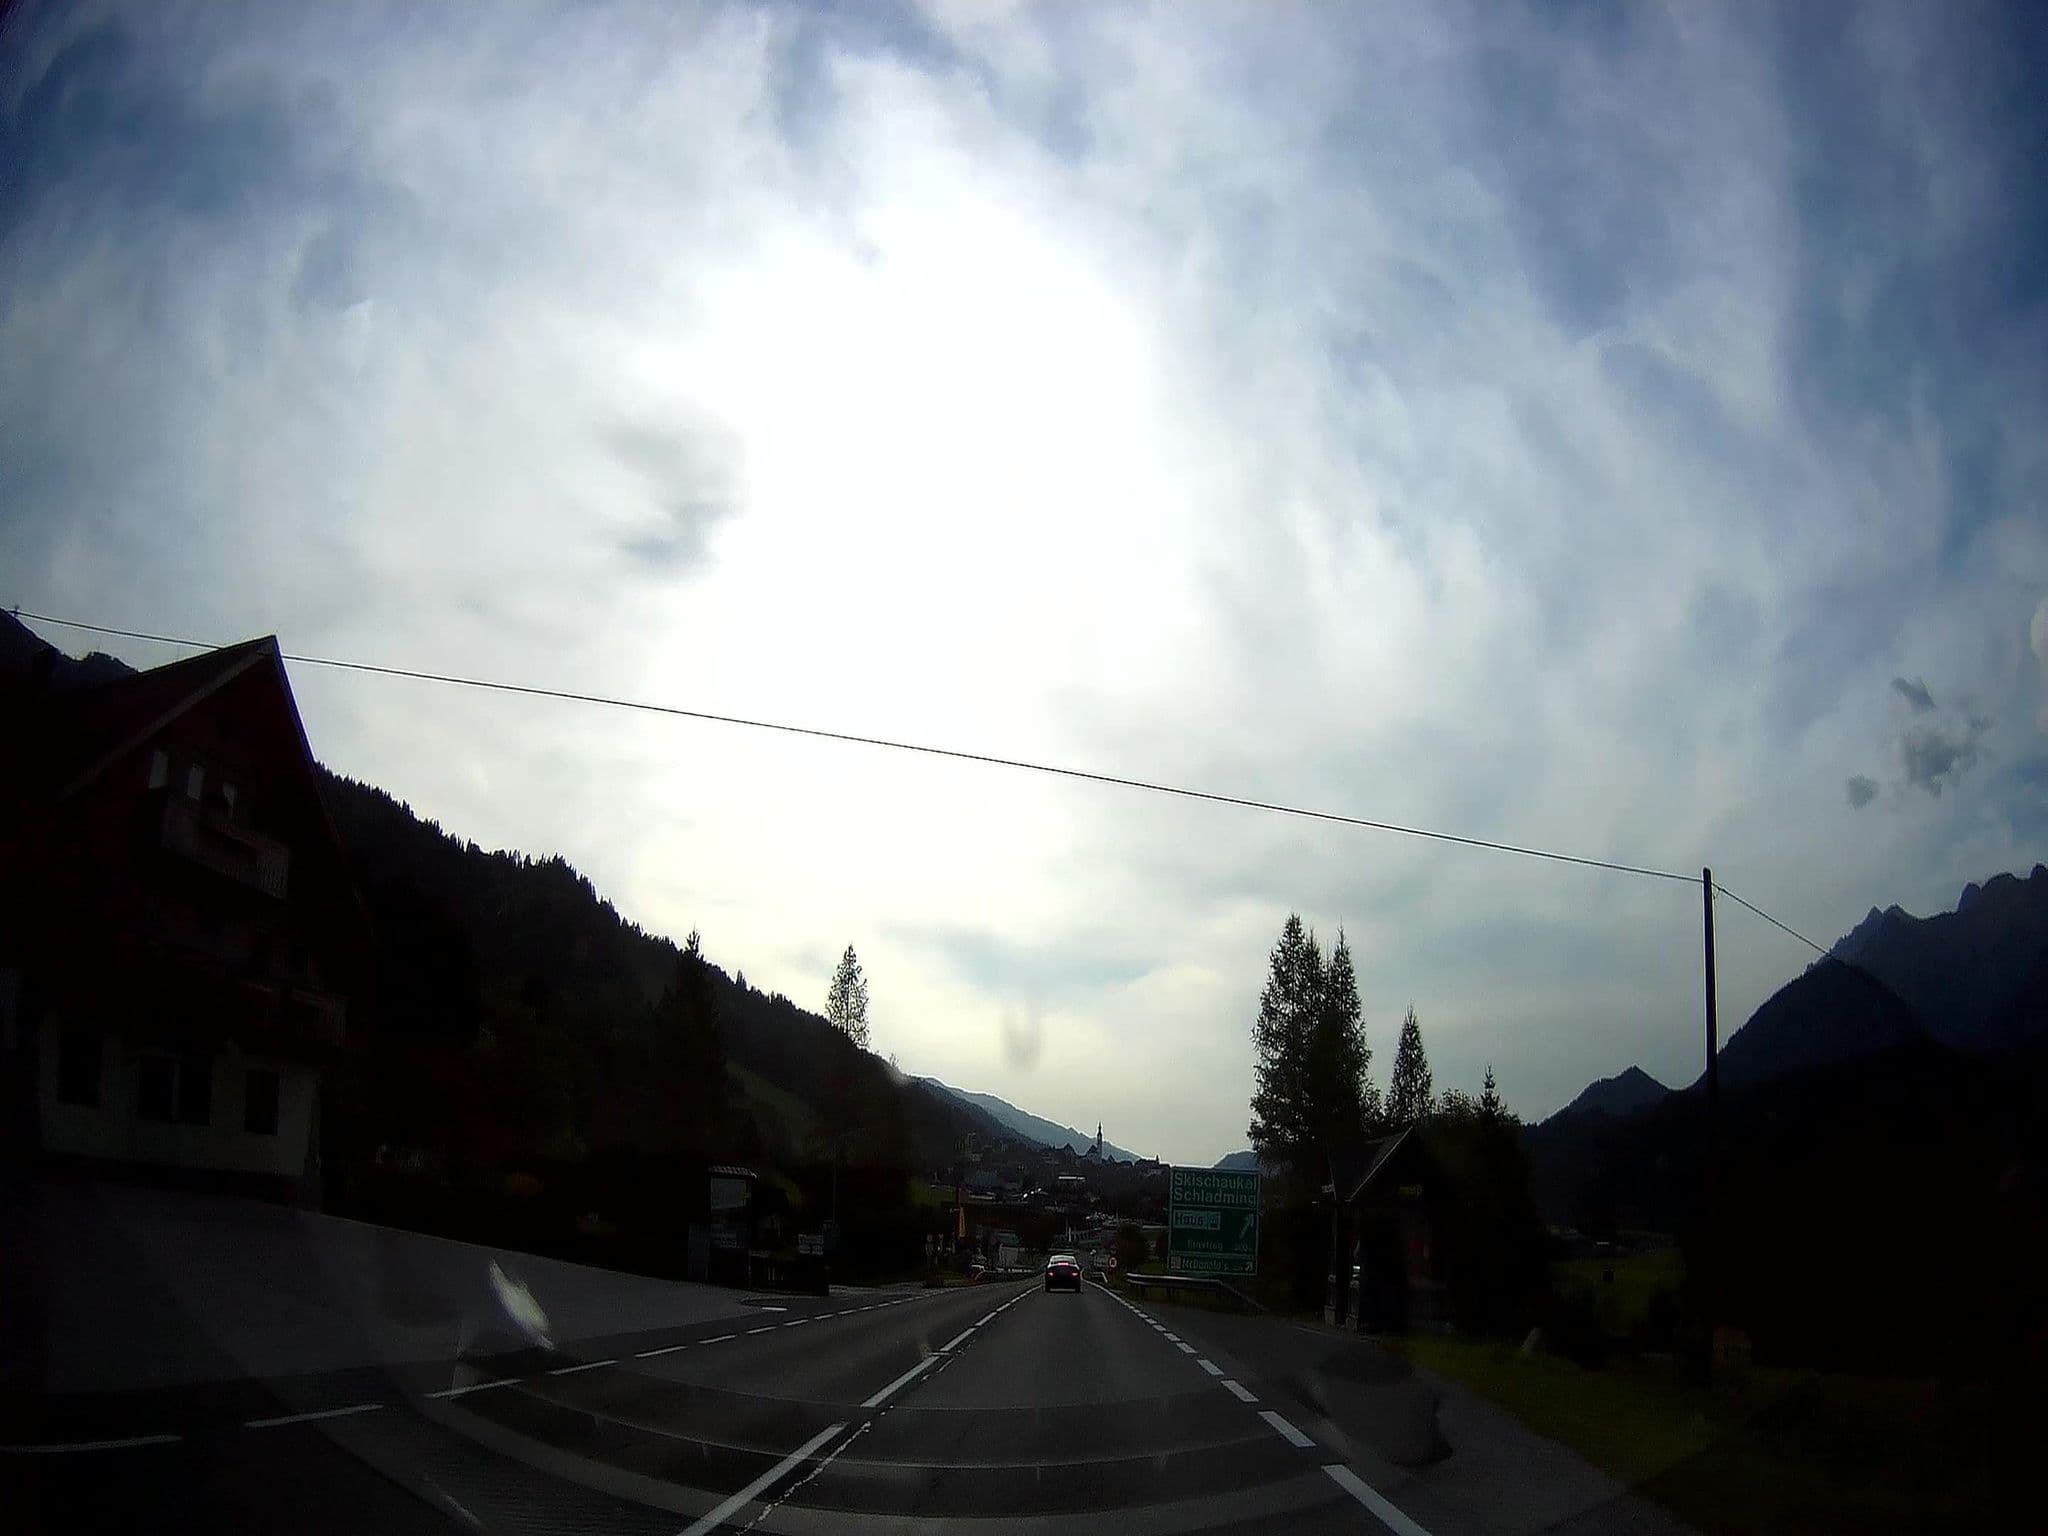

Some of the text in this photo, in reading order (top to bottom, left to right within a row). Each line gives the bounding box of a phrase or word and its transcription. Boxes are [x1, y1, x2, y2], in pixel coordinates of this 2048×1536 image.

[1174, 1172, 1257, 1190] Skischaukel
[1173, 1188, 1257, 1208] Schladming
[1175, 1212, 1204, 1225] Haus
